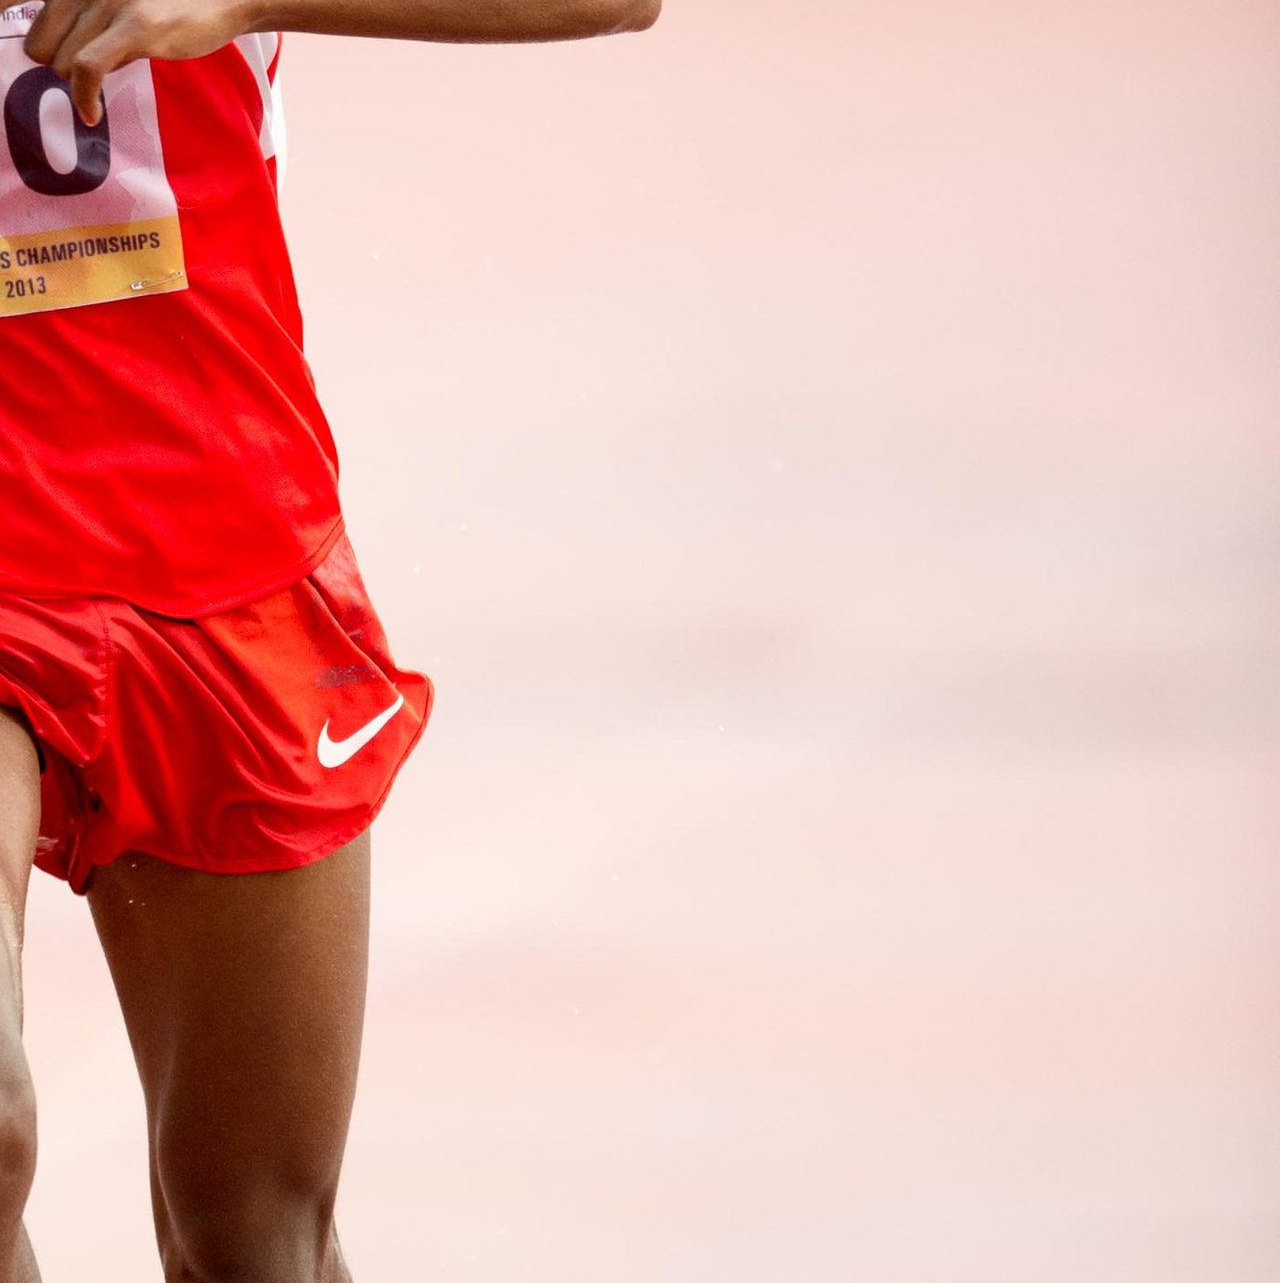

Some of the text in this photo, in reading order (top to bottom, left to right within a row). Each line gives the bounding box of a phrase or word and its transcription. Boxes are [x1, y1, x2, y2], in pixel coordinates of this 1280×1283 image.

[2, 6, 39, 22] India
[16, 232, 160, 267] CHAMPIONSHIPS
[5, 276, 47, 299] 2013
